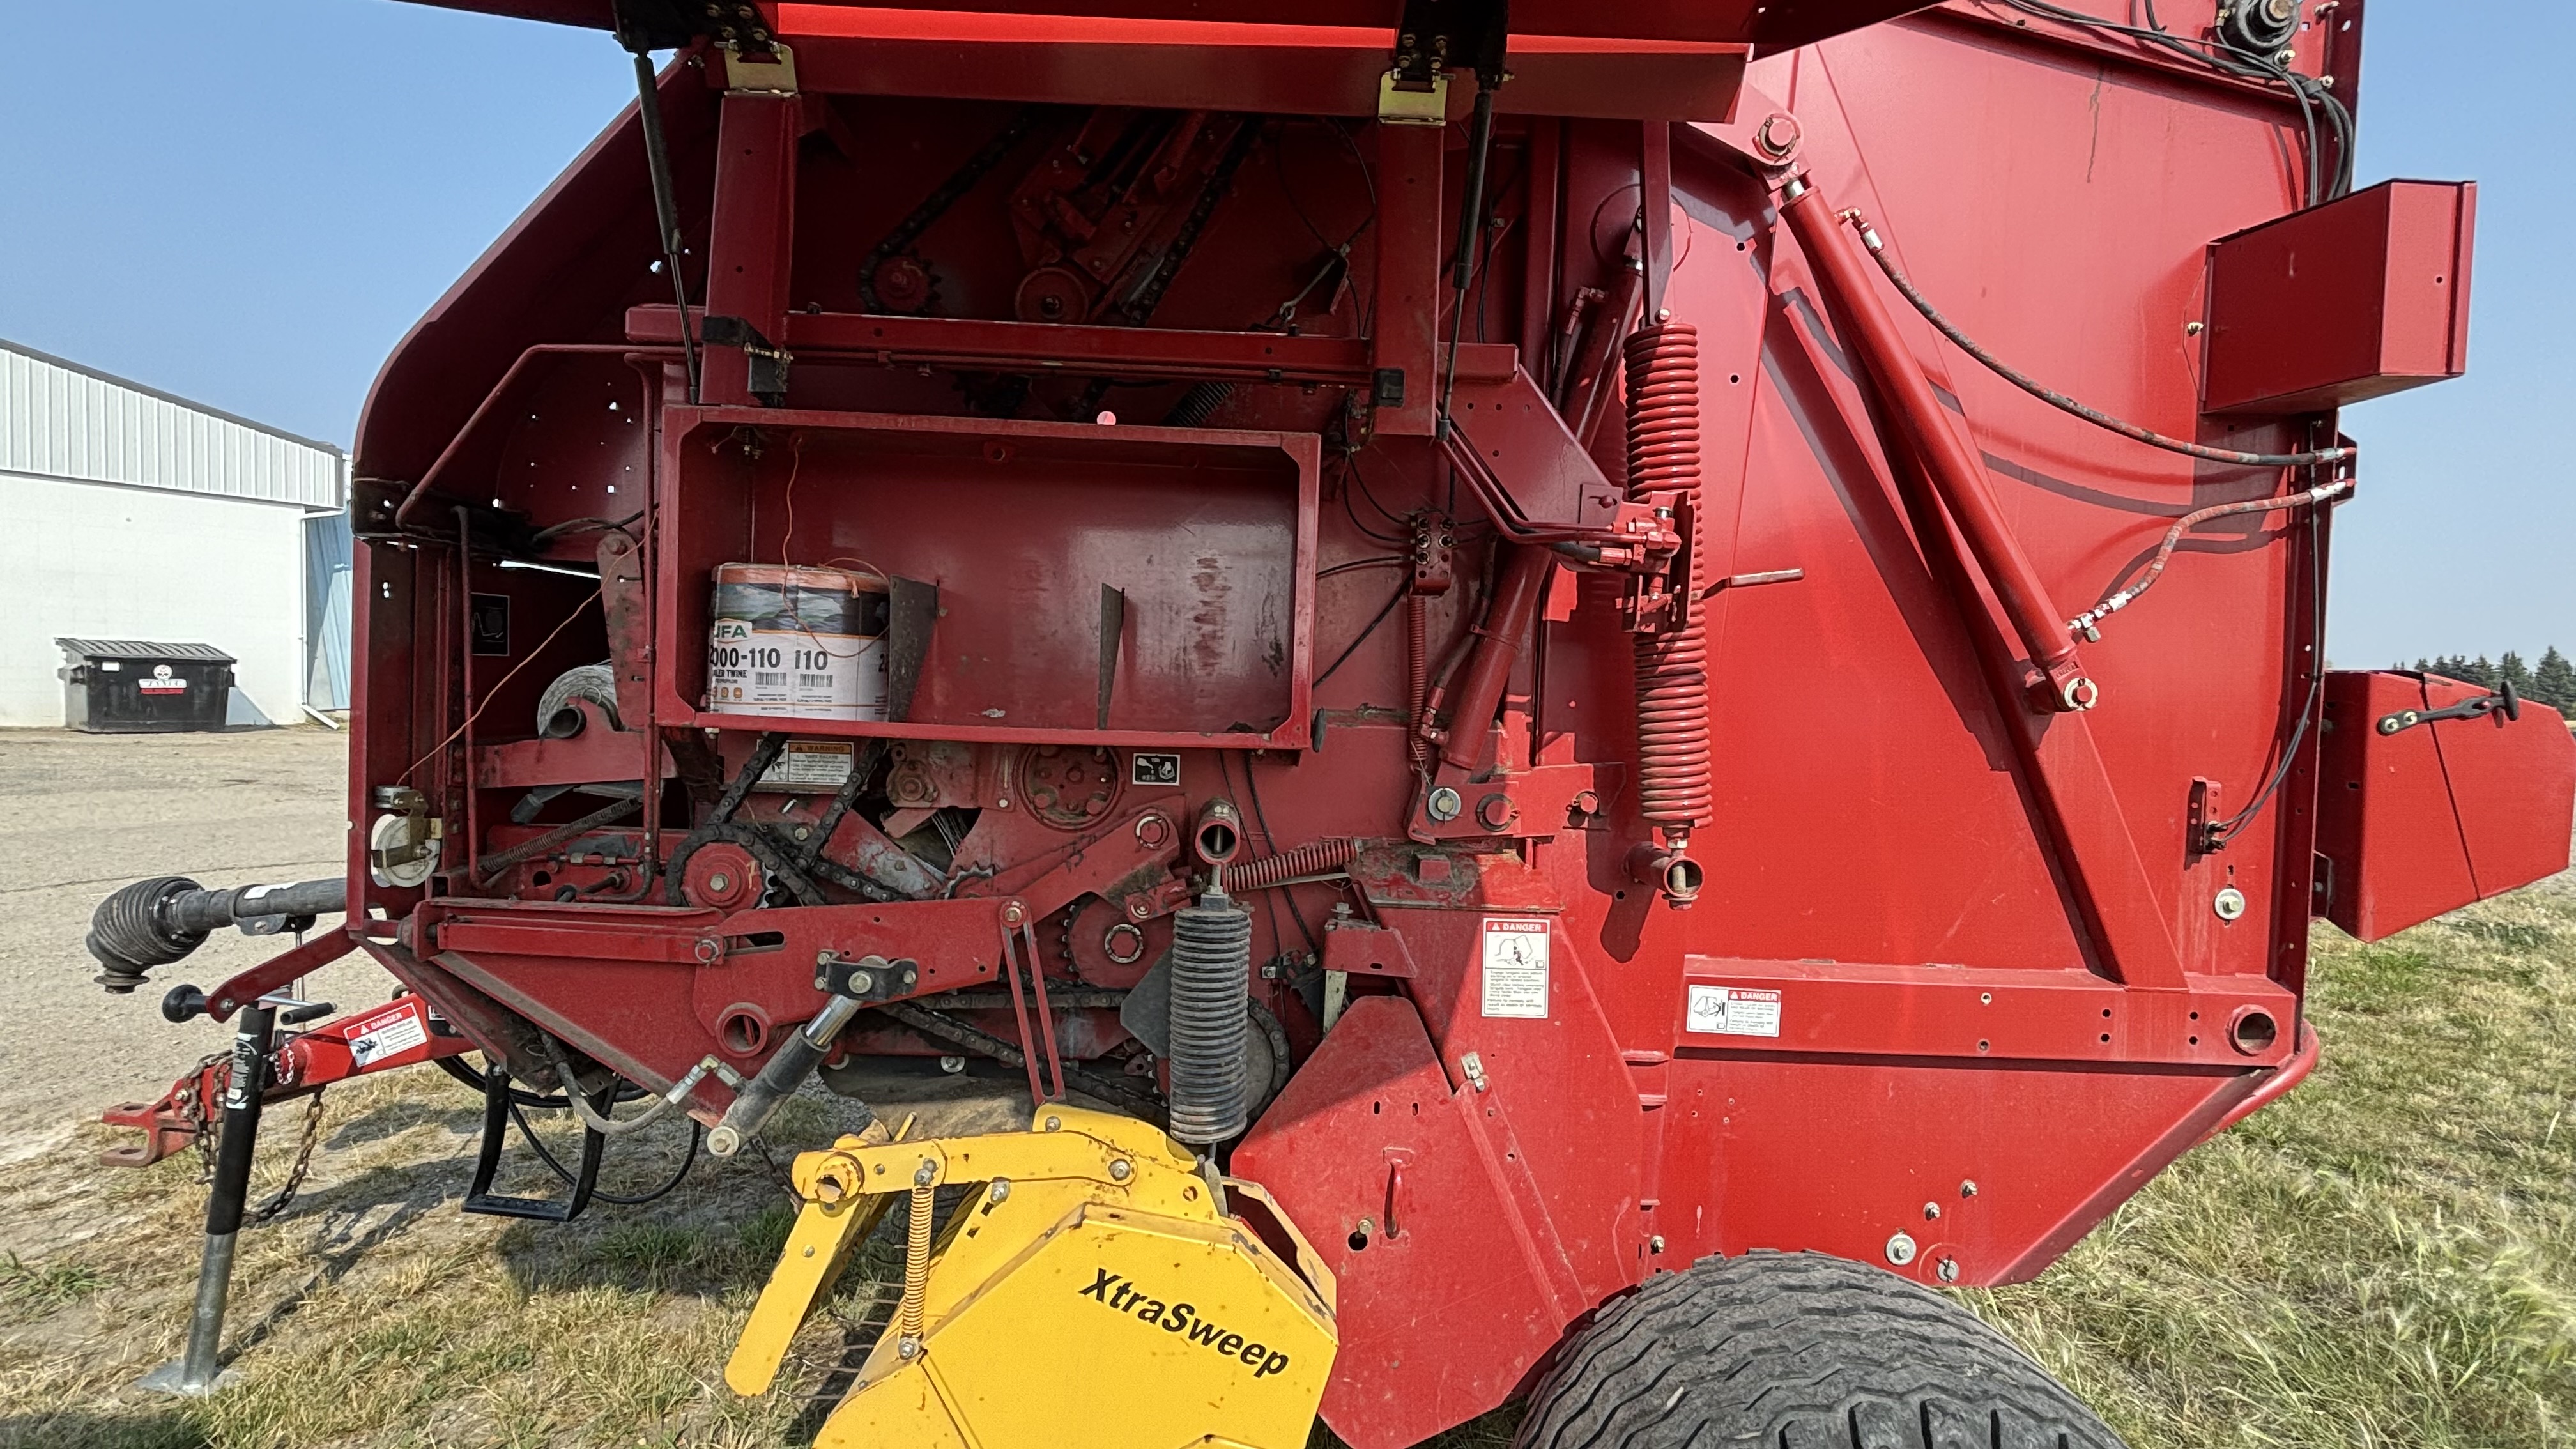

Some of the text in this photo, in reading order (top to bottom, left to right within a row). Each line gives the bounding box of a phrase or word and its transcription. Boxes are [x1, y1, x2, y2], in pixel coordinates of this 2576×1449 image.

[1503, 923, 1542, 931] DANGER
[1740, 992, 1777, 1000] DANGER
[370, 1012, 403, 1030] DANGER
[1077, 1268, 1289, 1378] XtraSweep
